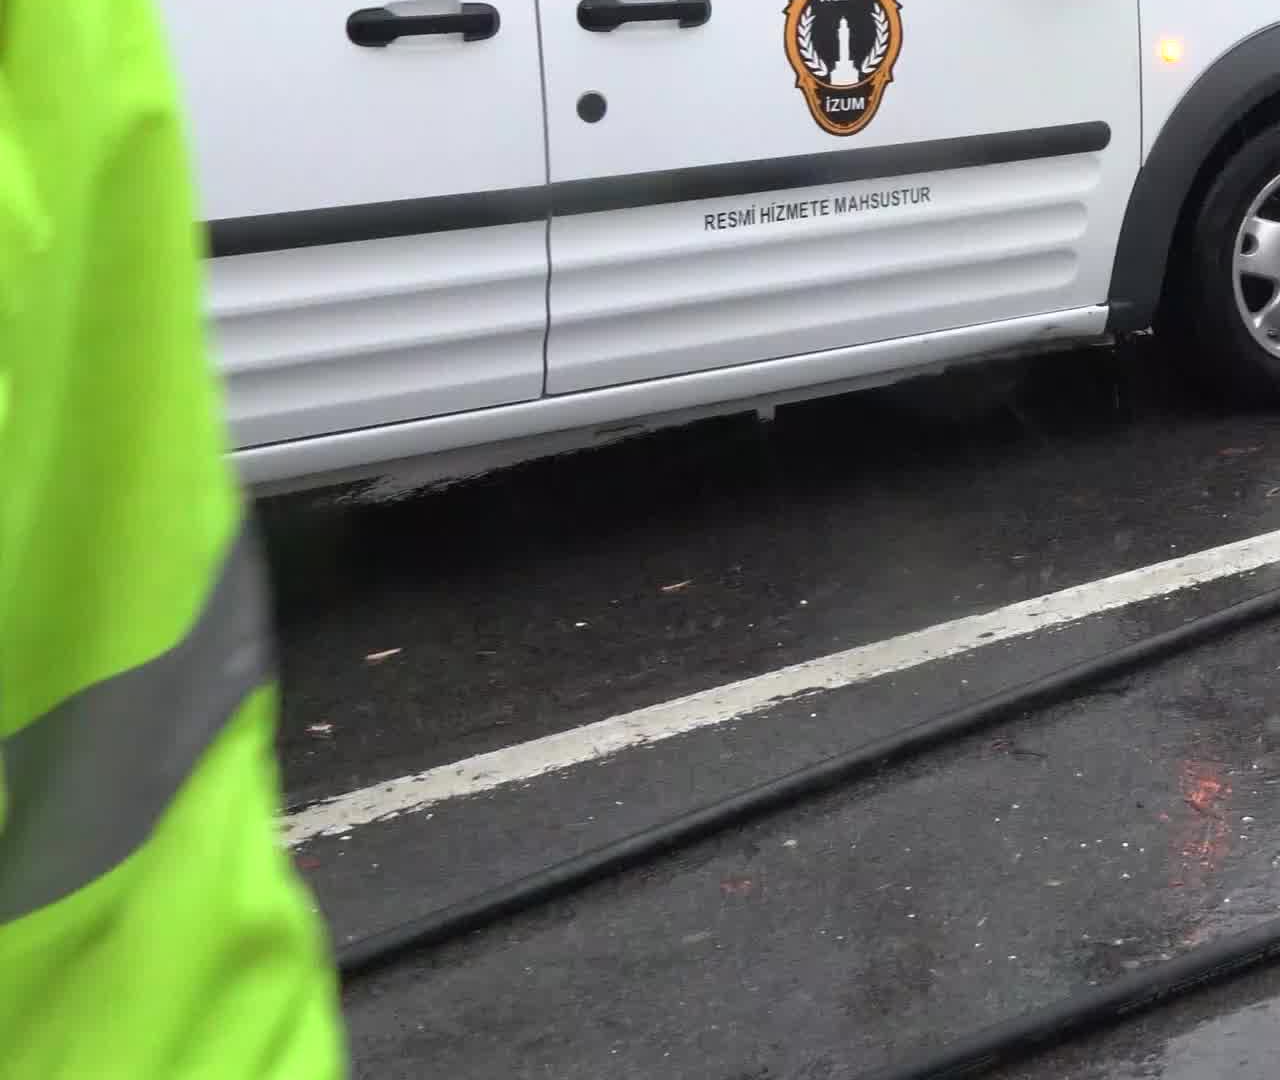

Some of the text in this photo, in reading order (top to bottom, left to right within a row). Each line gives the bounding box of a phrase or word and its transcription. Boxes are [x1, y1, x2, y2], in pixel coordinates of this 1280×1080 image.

[825, 96, 865, 113] İZUM
[704, 186, 931, 231] RESMİ HİZMETE MAHSUSTUR
